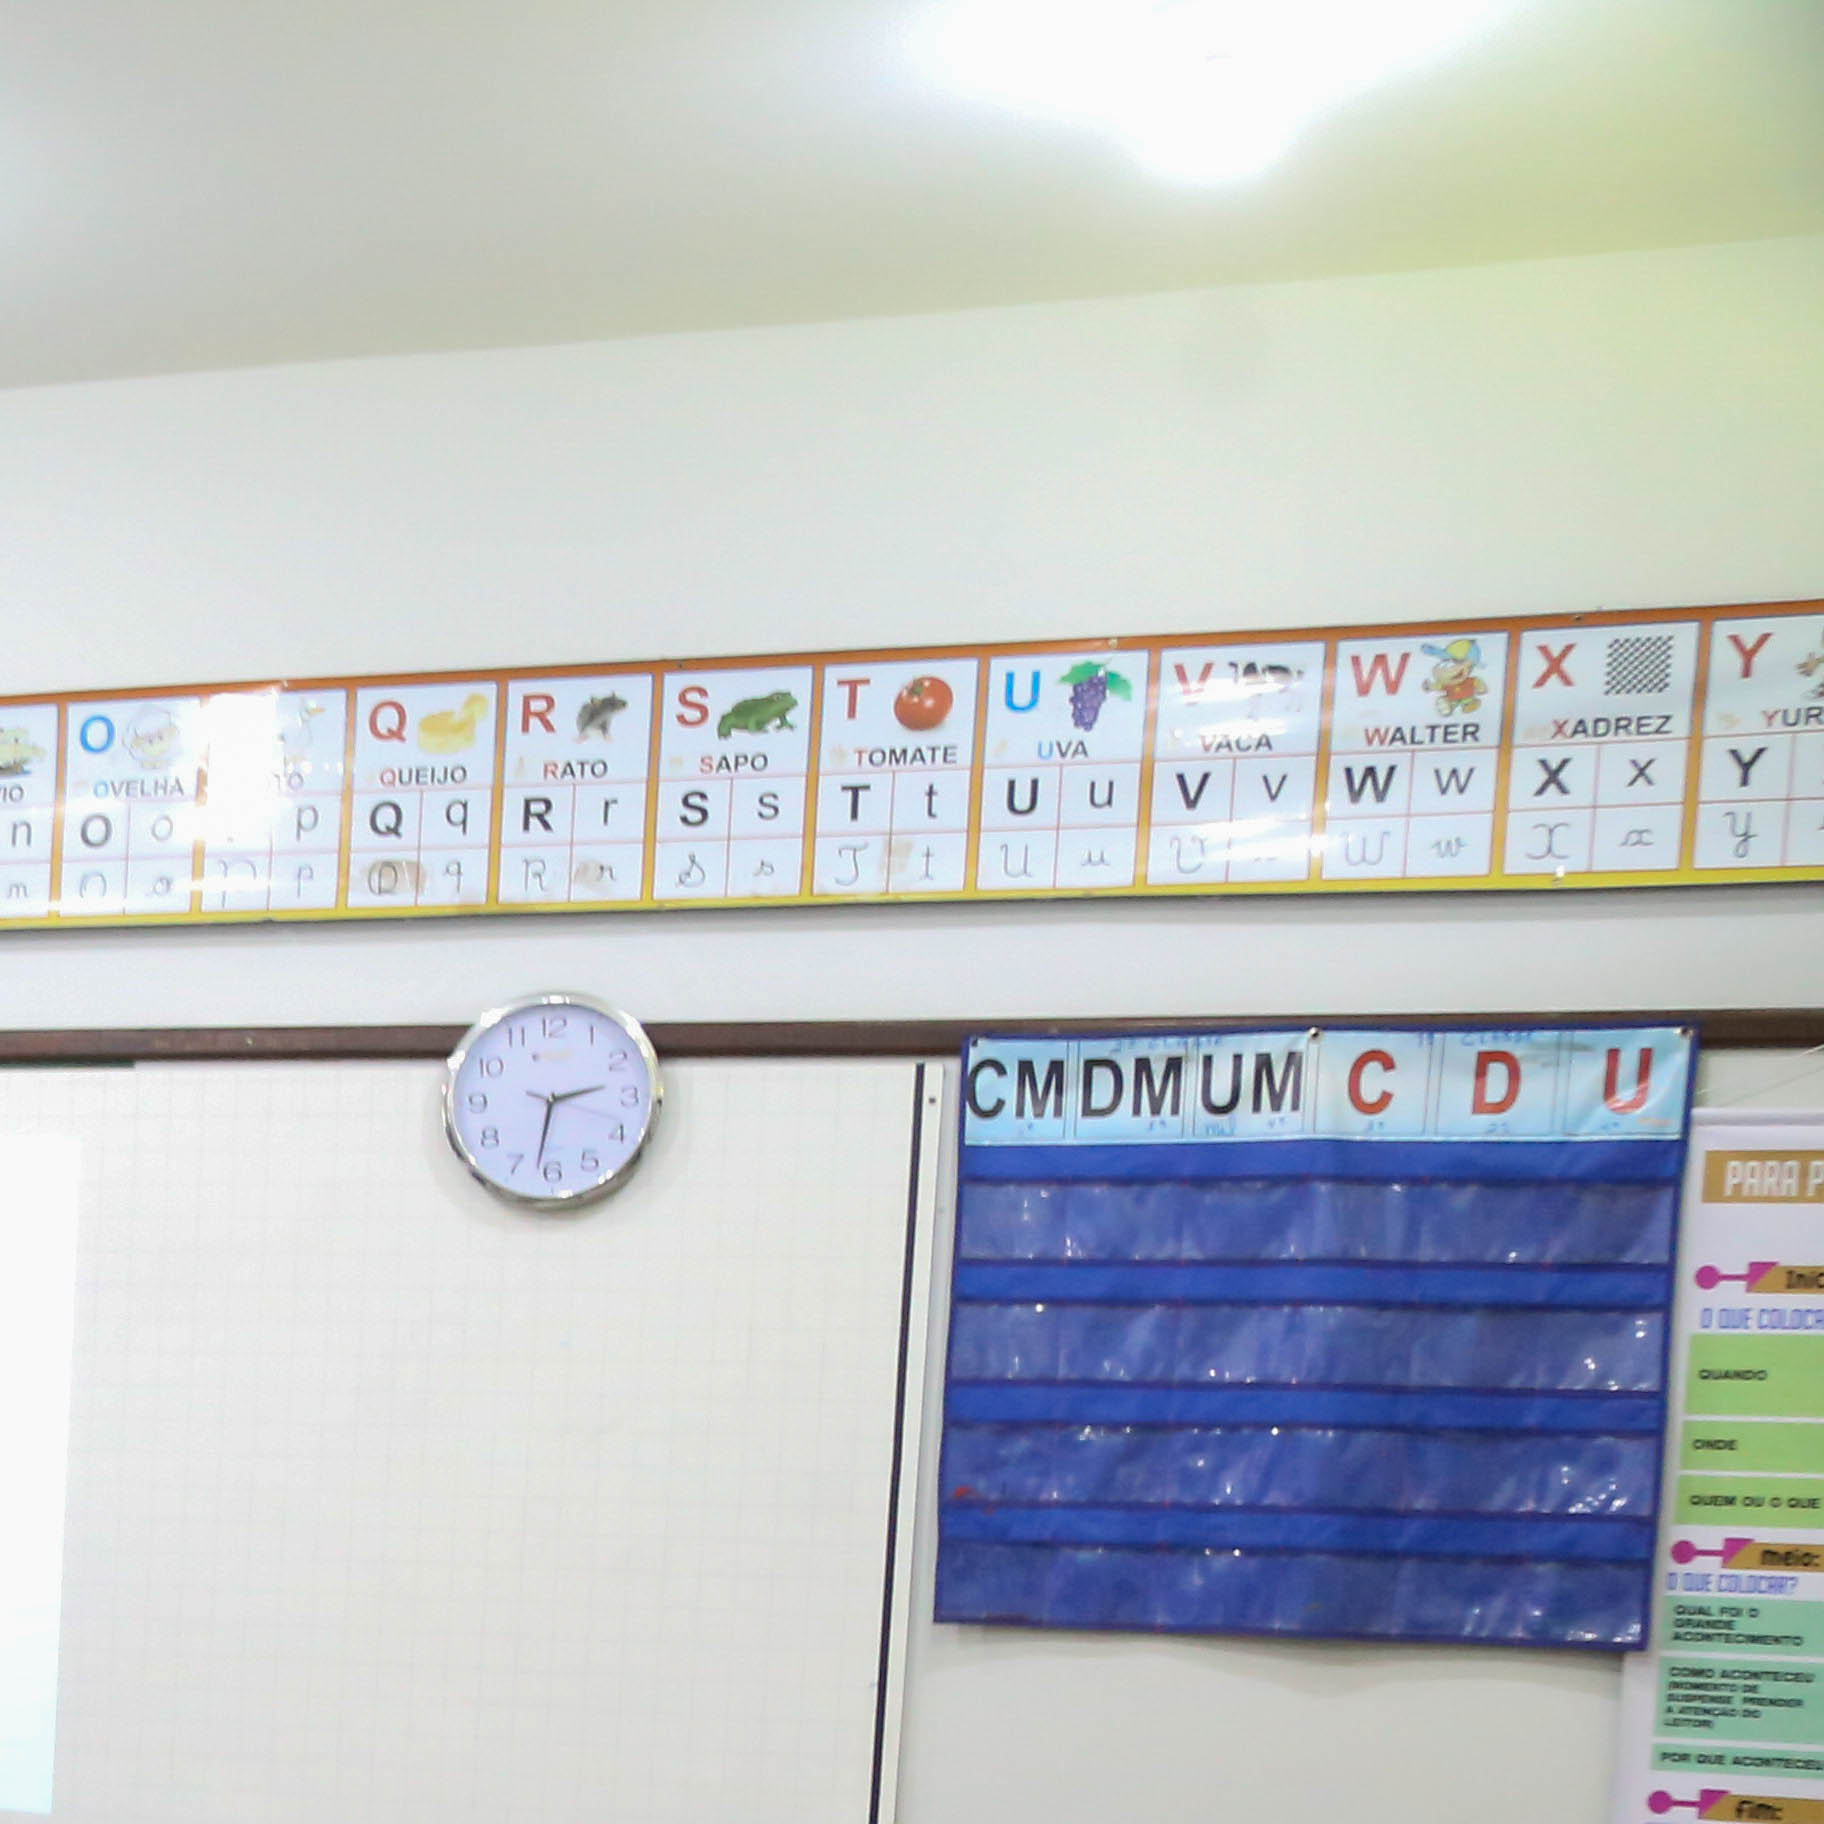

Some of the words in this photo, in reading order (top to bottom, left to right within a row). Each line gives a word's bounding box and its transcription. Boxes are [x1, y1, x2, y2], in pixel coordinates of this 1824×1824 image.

[1532, 643, 1577, 689] X
[1728, 633, 1774, 678] Y
[1351, 652, 1411, 697] W
[837, 677, 870, 720] T
[1004, 670, 1041, 714] U
[521, 694, 557, 734] R
[675, 685, 710, 729] S
[368, 700, 408, 742] Q
[1551, 715, 1674, 740] XADREZ
[79, 714, 115, 755] O
[1364, 724, 1479, 746] WALTER
[856, 746, 957, 766] TOMATE
[1038, 740, 1089, 760] UVA
[380, 766, 467, 787] QUEIJO
[543, 761, 608, 780] RATO
[699, 754, 768, 774] SAPO
[1728, 747, 1768, 788] Y
[94, 778, 184, 798] OVELHA
[1344, 765, 1397, 803] W
[1534, 757, 1572, 797] X
[841, 784, 871, 821] T
[1006, 778, 1038, 816] U
[1176, 772, 1211, 810] V
[369, 802, 403, 838] Q
[522, 797, 554, 832] R
[679, 791, 709, 827] S
[80, 814, 113, 848] O
[508, 1026, 525, 1048] 11
[542, 1016, 567, 1039] 12
[479, 1057, 504, 1079] 10
[609, 1050, 628, 1072] 2
[1348, 1049, 1395, 1115] C
[1472, 1050, 1521, 1115] D
[1604, 1048, 1653, 1114] U
[469, 1092, 487, 1114] 9
[620, 1085, 638, 1108] 3
[481, 1126, 500, 1148] 8
[609, 1123, 626, 1144] 4
[507, 1153, 524, 1175] 7
[543, 1161, 562, 1183] 6
[580, 1149, 599, 1172] 5
[1724, 1161, 1800, 1196] PARA
[1698, 1369, 1768, 1381] QUANDO
[1693, 1438, 1738, 1450] ONDE
[1689, 1495, 1737, 1506] QUEM
